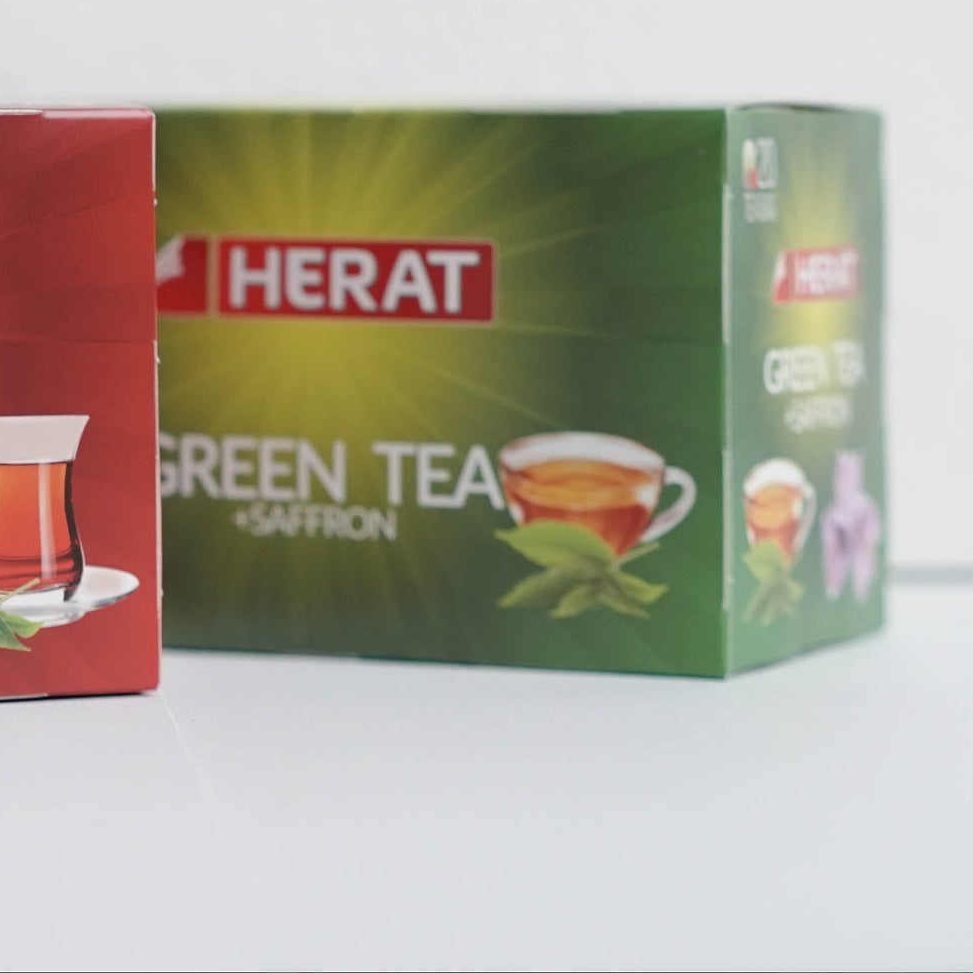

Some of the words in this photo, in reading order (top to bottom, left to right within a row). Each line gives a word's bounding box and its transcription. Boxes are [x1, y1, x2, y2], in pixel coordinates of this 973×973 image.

[229, 246, 481, 314] HERAT
[371, 440, 505, 510] TEA
[234, 502, 397, 541] +SAFFRON
